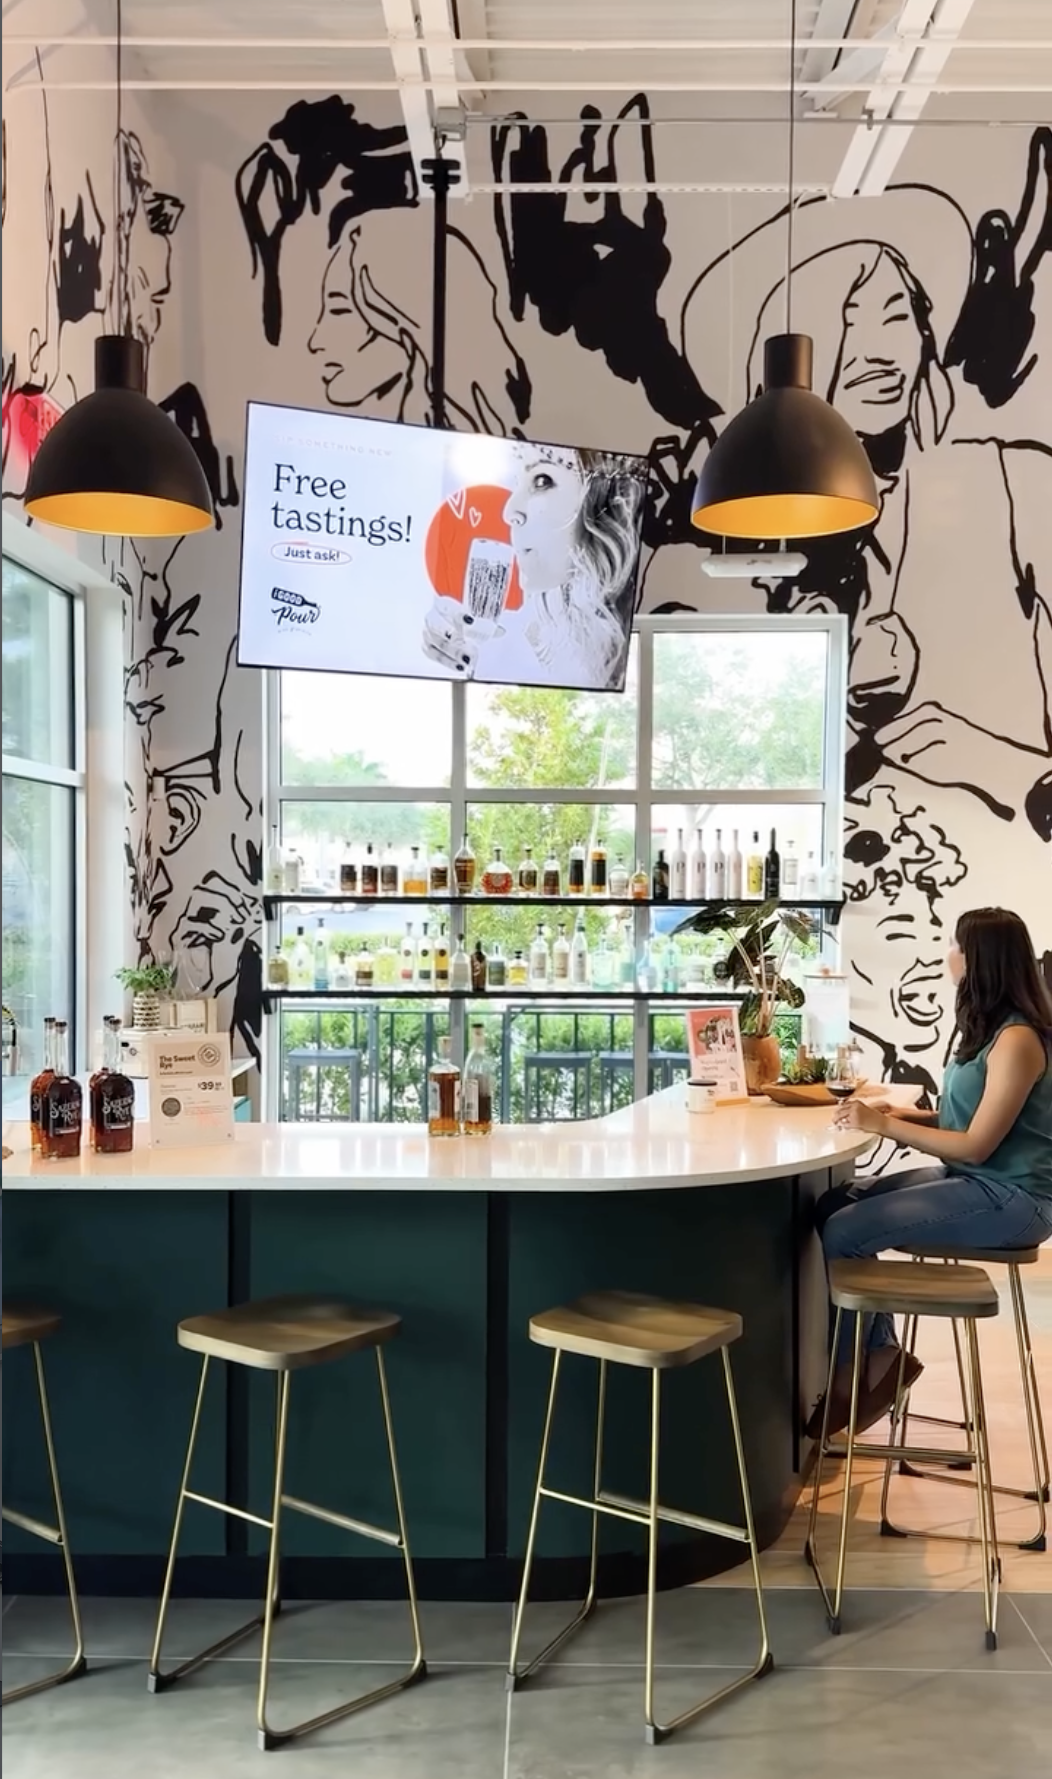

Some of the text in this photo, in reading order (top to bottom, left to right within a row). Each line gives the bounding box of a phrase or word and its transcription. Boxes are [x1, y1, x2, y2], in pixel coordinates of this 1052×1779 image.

[273, 462, 347, 500] Free
[271, 500, 412, 547] tastings!
[284, 546, 340, 562] Just ask!
